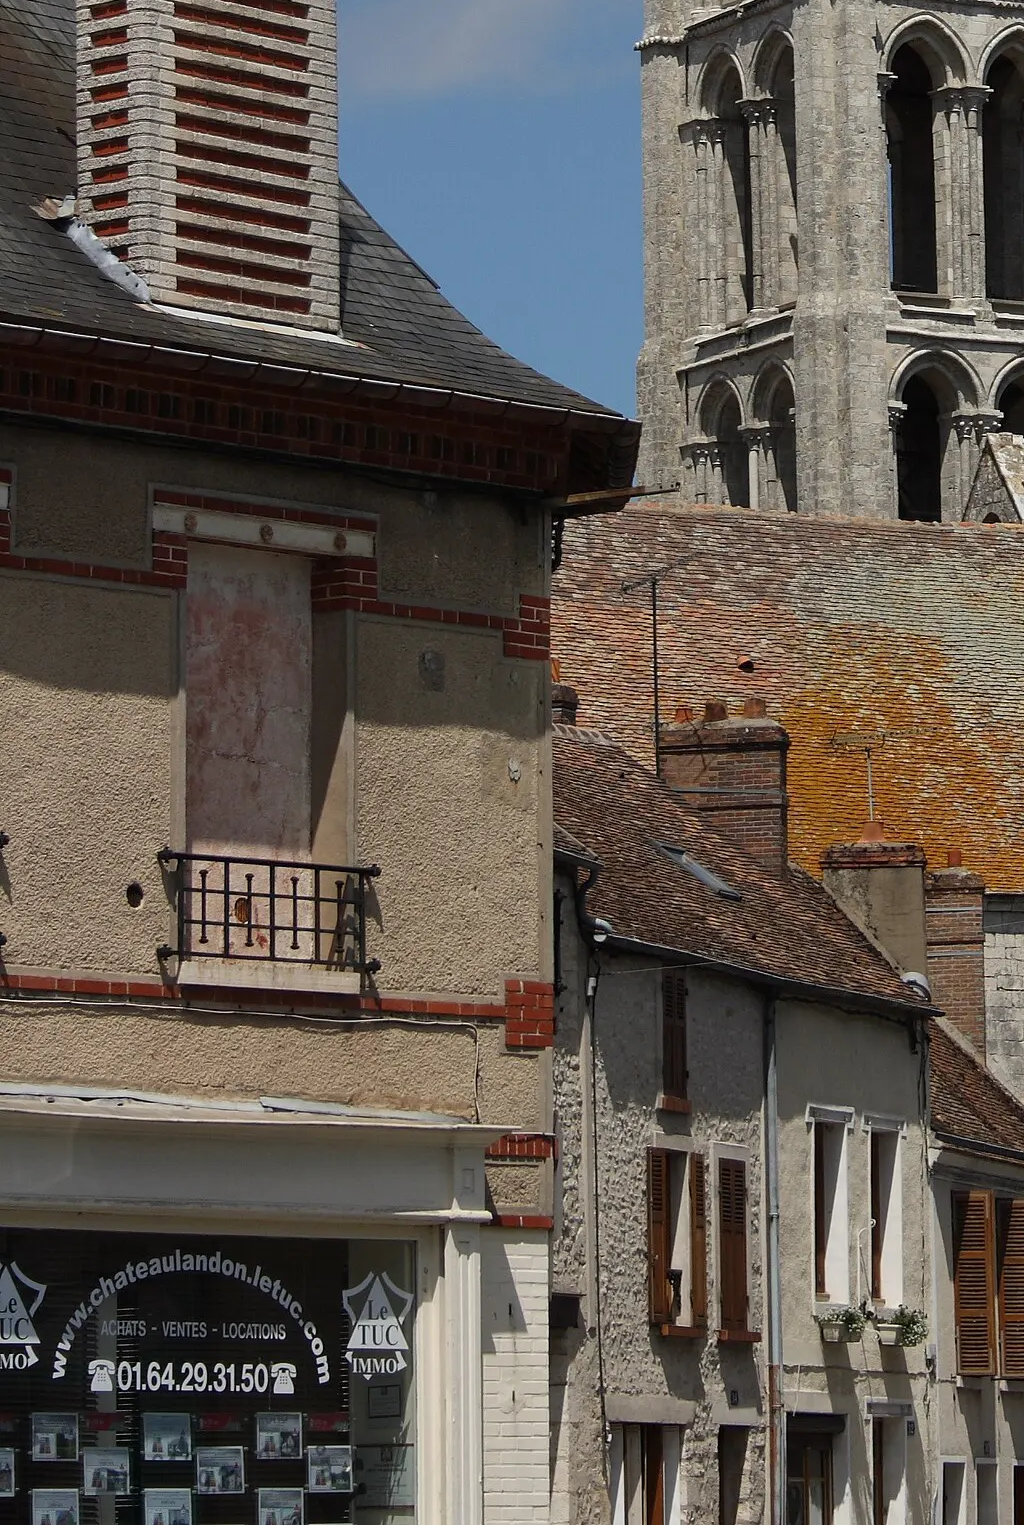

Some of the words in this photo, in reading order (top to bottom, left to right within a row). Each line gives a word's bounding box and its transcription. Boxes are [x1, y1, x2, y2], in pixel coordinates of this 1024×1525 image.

[52, 1249, 330, 1384] www.chateaulandon.letuc.com
[367, 1299, 389, 1321] Le
[0, 1317, 30, 1341] UC
[100, 1320, 147, 1337] ACHATS
[162, 1321, 208, 1338] VENTES
[222, 1322, 287, 1340] LOCATIONS
[358, 1324, 399, 1346] TUC
[0, 1353, 27, 1370] MO
[352, 1358, 398, 1374] IMMO
[117, 1360, 269, 1393] 01.64.29.31.50
